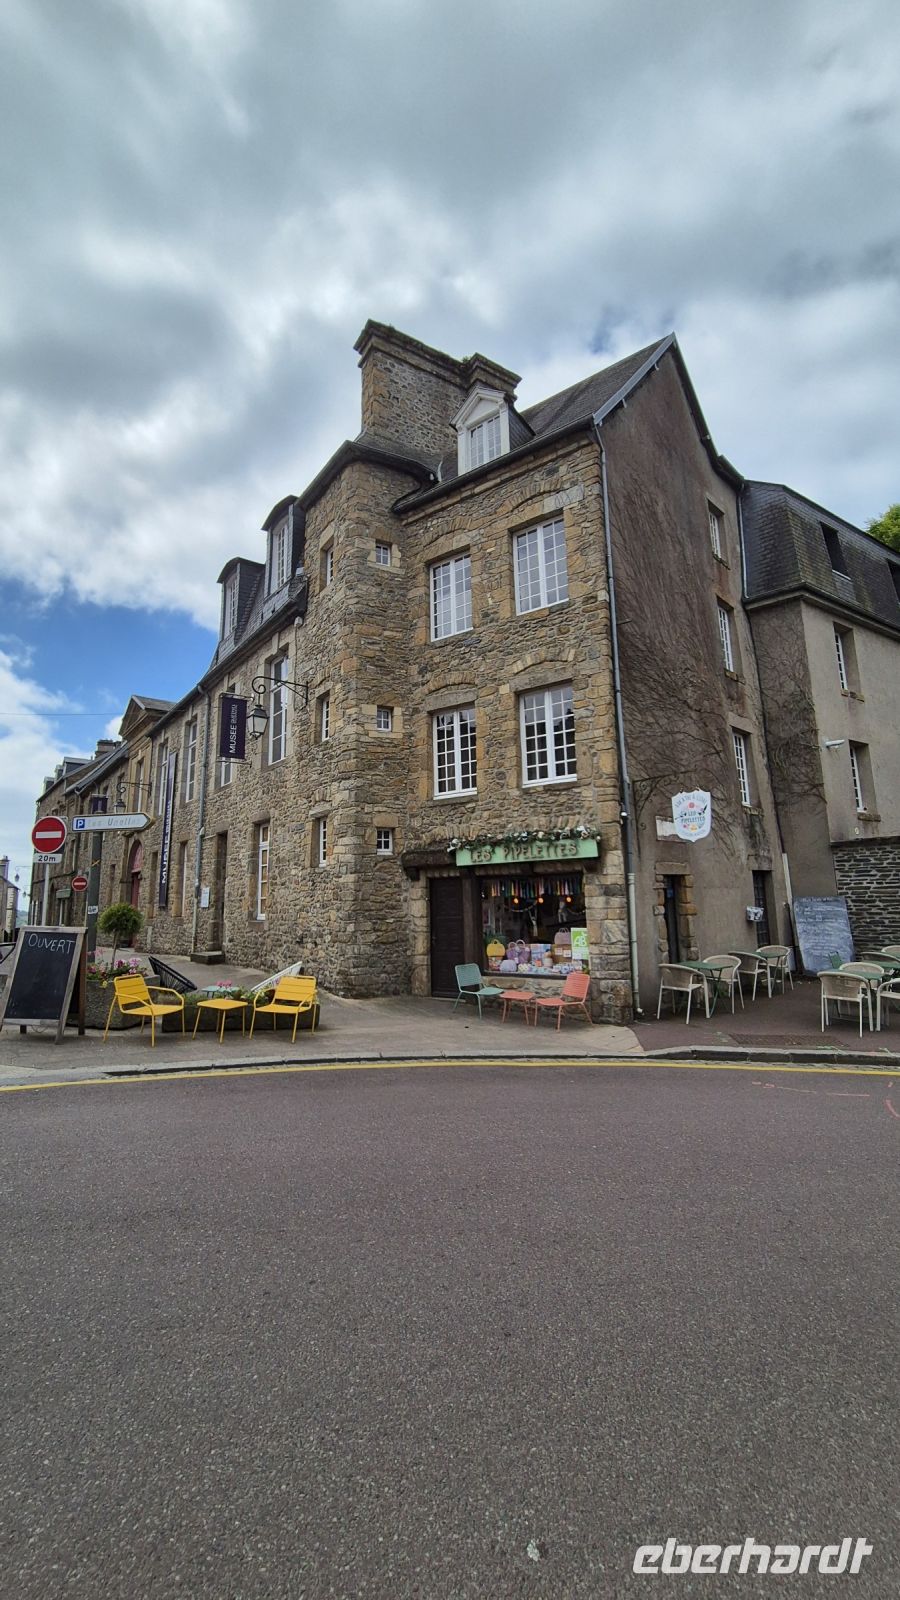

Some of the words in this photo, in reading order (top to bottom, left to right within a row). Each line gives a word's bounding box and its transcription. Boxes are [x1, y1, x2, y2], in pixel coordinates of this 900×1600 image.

[229, 724, 237, 754] MUSEE
[470, 848, 493, 863] LES
[502, 842, 578, 861] PIPELETTES
[28, 933, 76, 954] OUVERT
